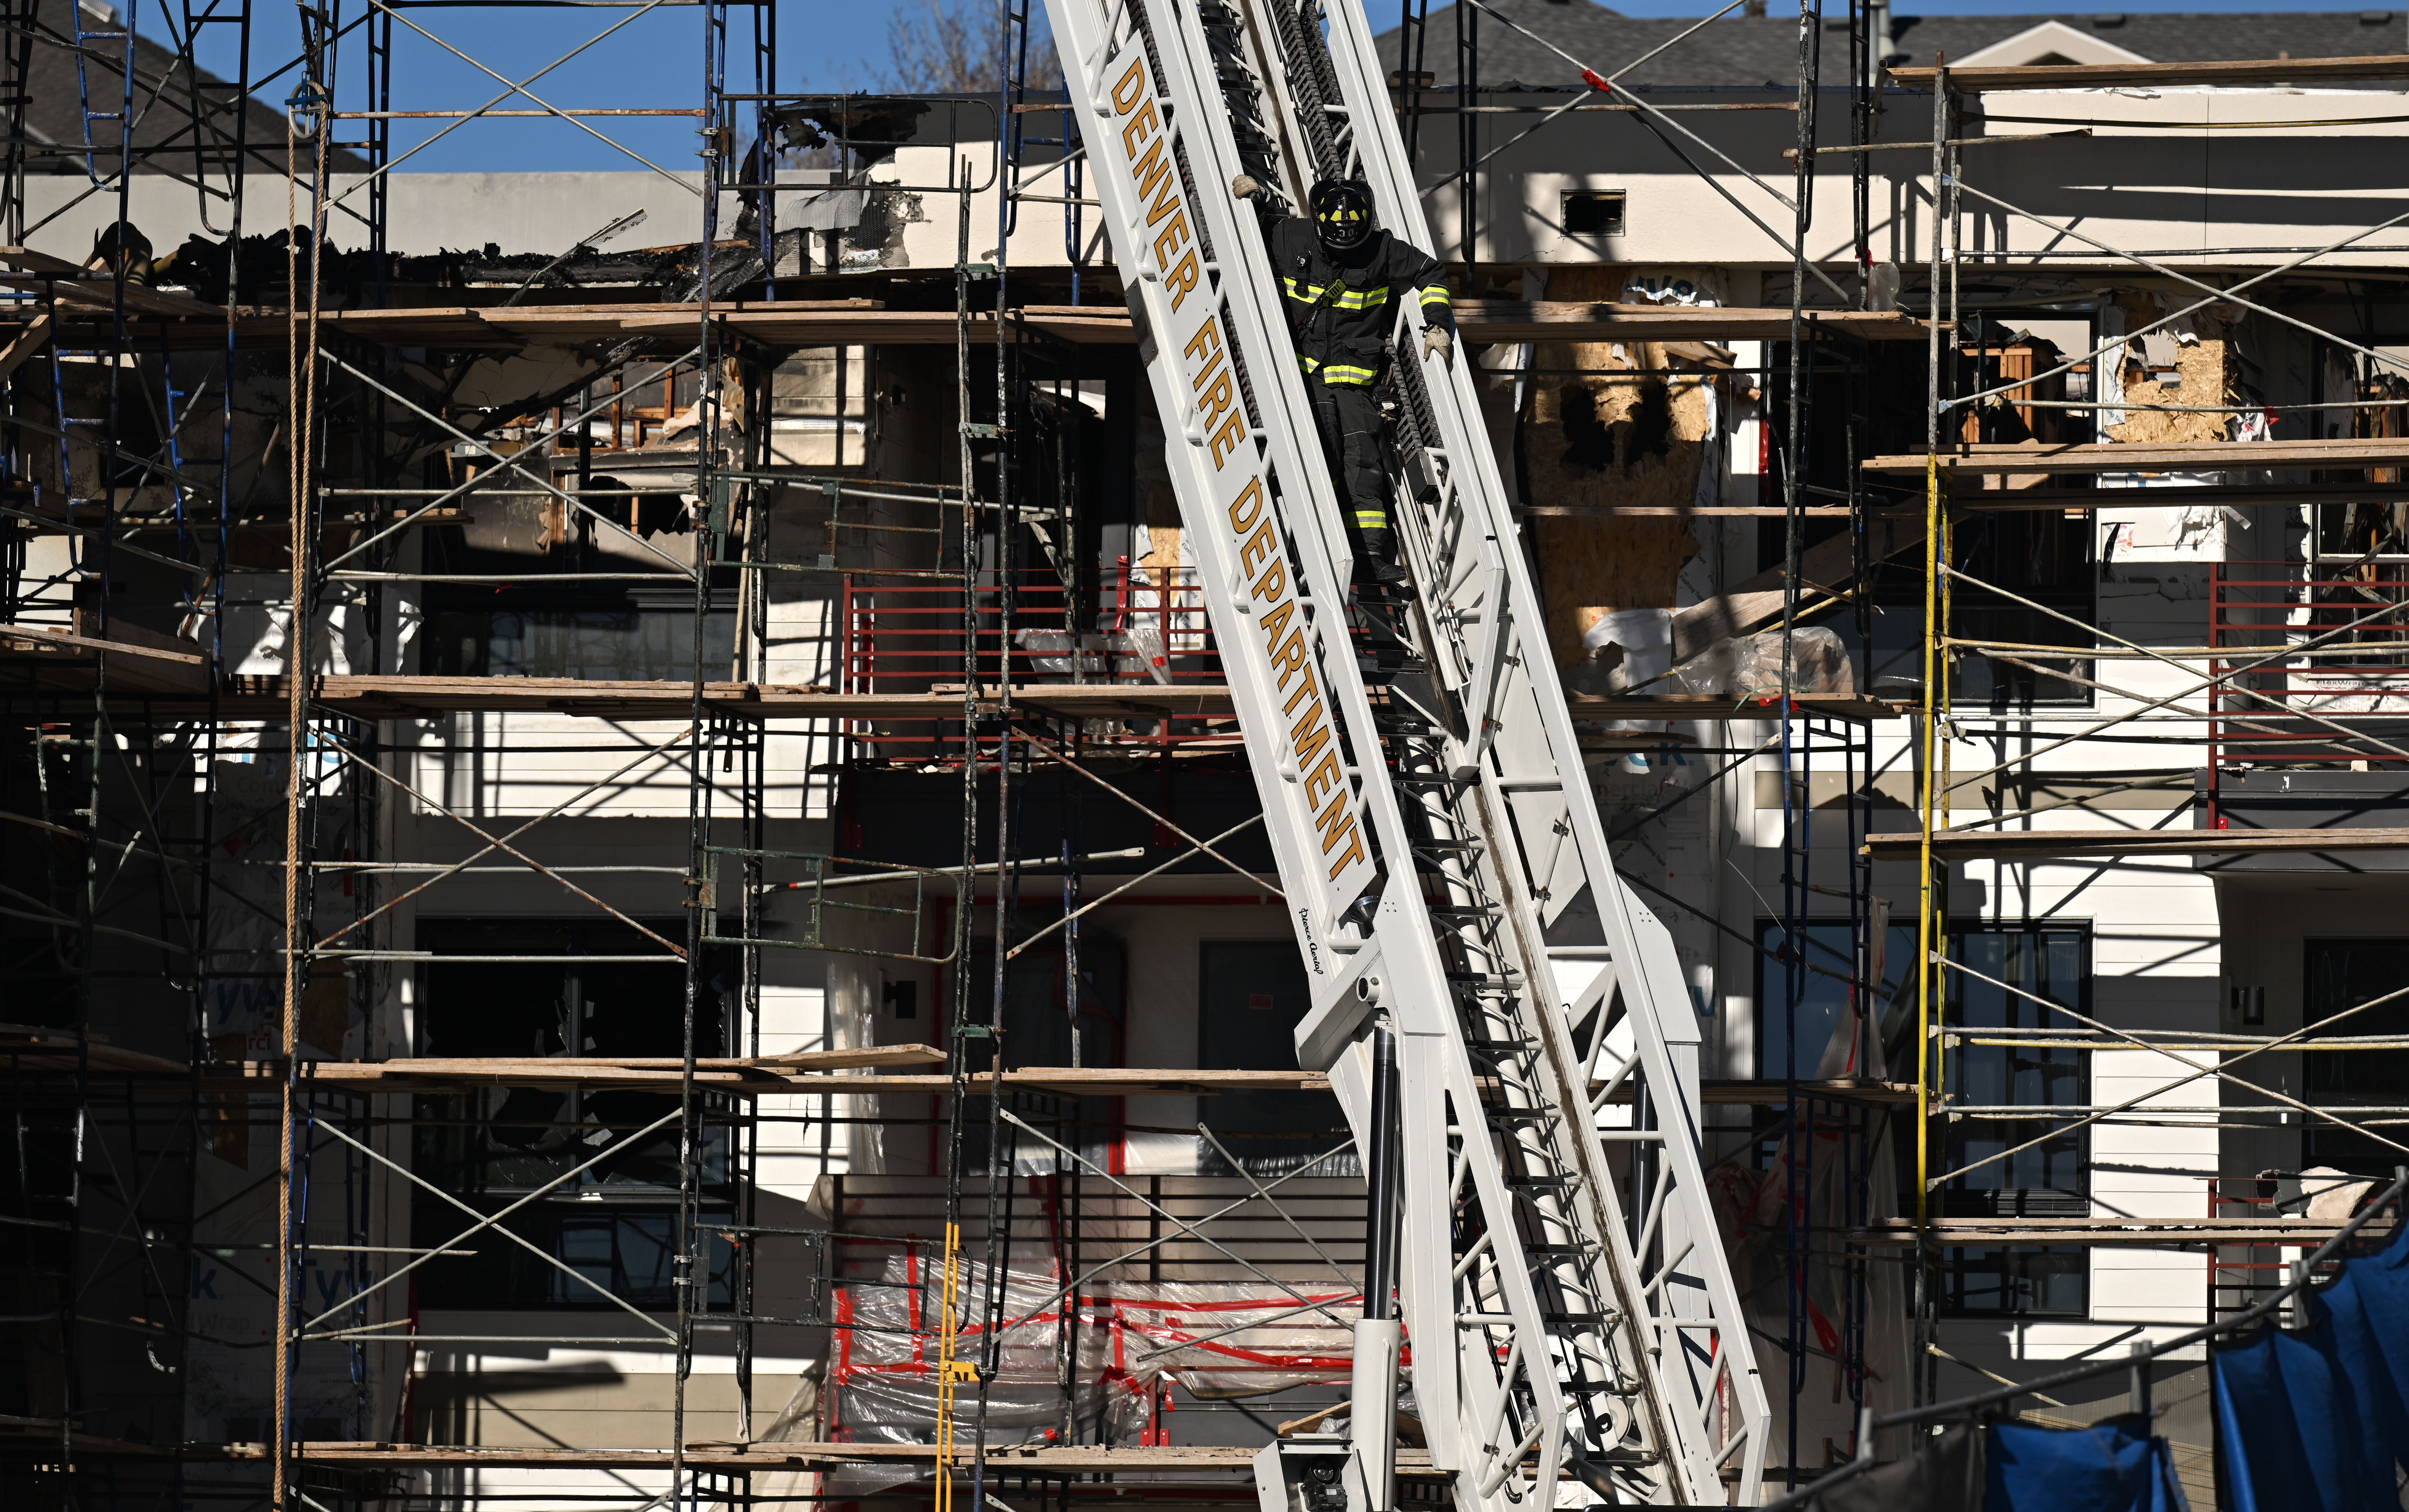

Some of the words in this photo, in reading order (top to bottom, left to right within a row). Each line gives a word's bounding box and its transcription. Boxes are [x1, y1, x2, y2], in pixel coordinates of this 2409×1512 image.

[1338, 228, 1354, 237] 30
[1110, 56, 1198, 313] DENVER
[1184, 315, 1246, 471] FIRE
[1228, 475, 1365, 881] DEPARTMENT
[1697, 553, 1706, 564] Tape
[1679, 574, 1695, 593] Flashing
[1657, 816, 1667, 828] Tape
[1622, 842, 1633, 853] Tape
[1639, 837, 1656, 856] Flashing
[1655, 854, 1666, 867] Tape
